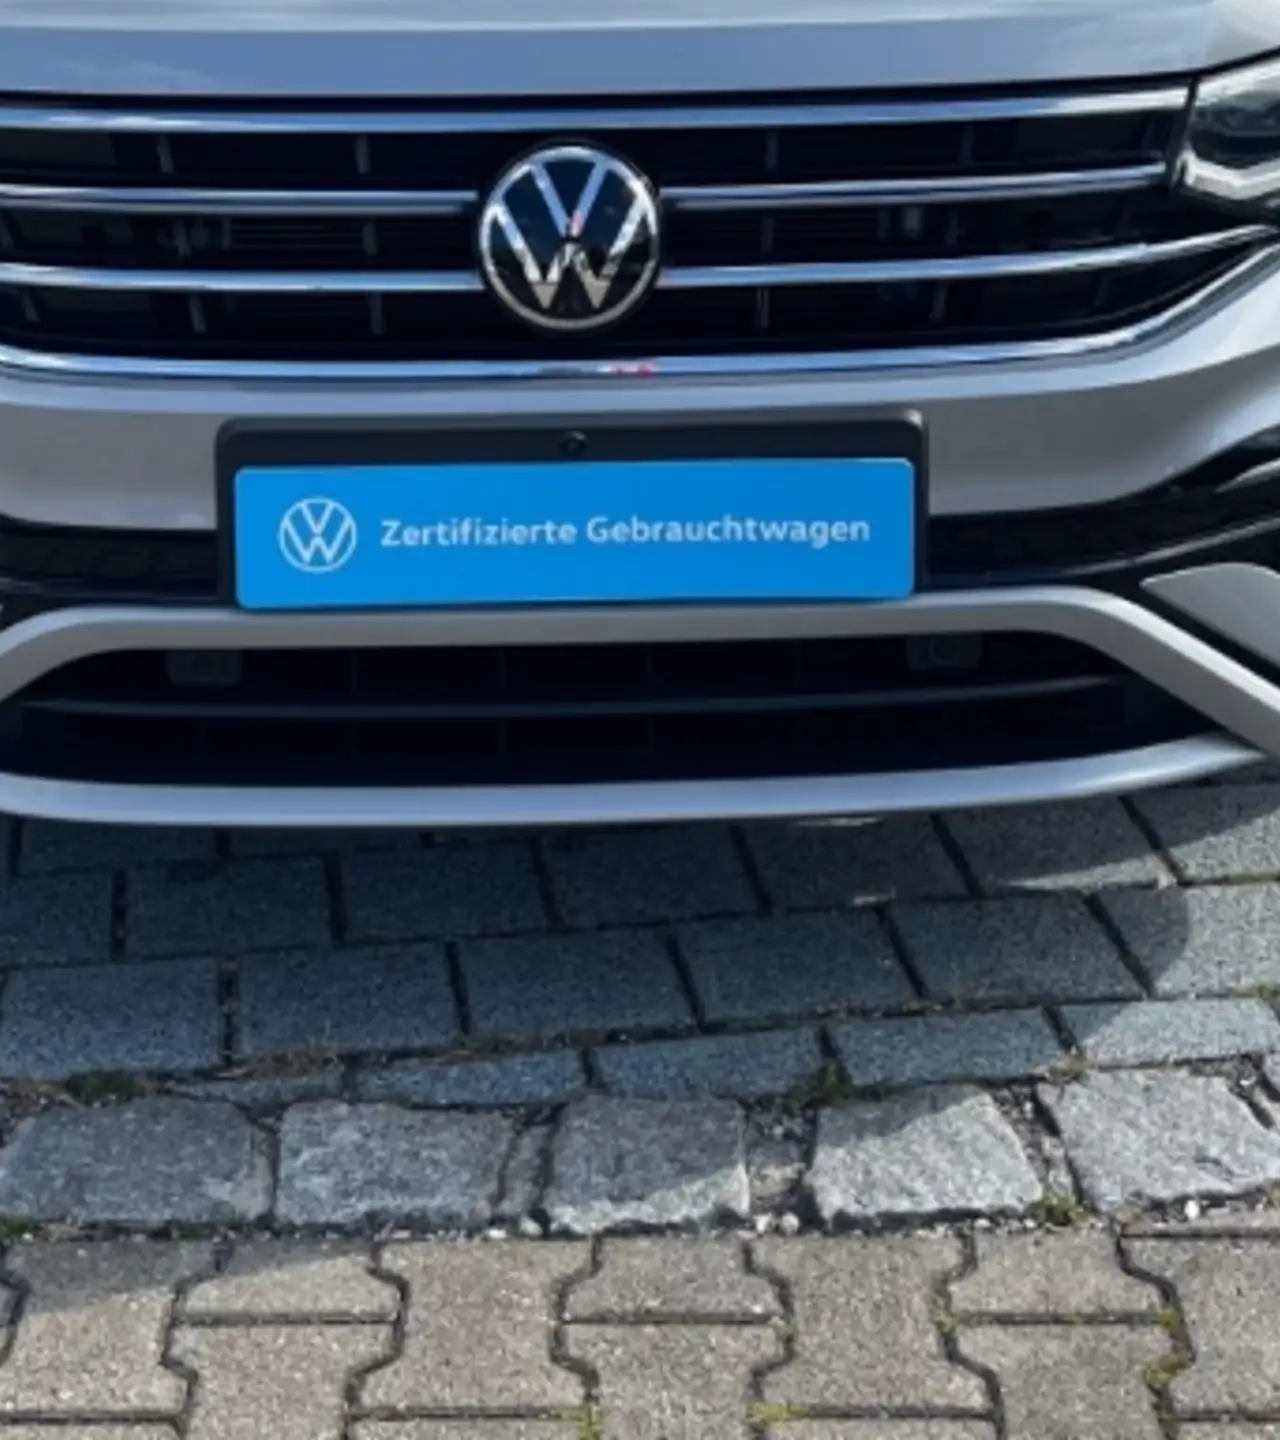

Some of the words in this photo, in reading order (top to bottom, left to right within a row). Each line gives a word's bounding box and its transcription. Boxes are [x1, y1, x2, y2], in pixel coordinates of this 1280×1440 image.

[479, 147, 658, 328] VW
[279, 498, 357, 573] VW
[380, 517, 578, 547] Zertifizierte
[586, 514, 870, 549] Gebrauchtwagen
